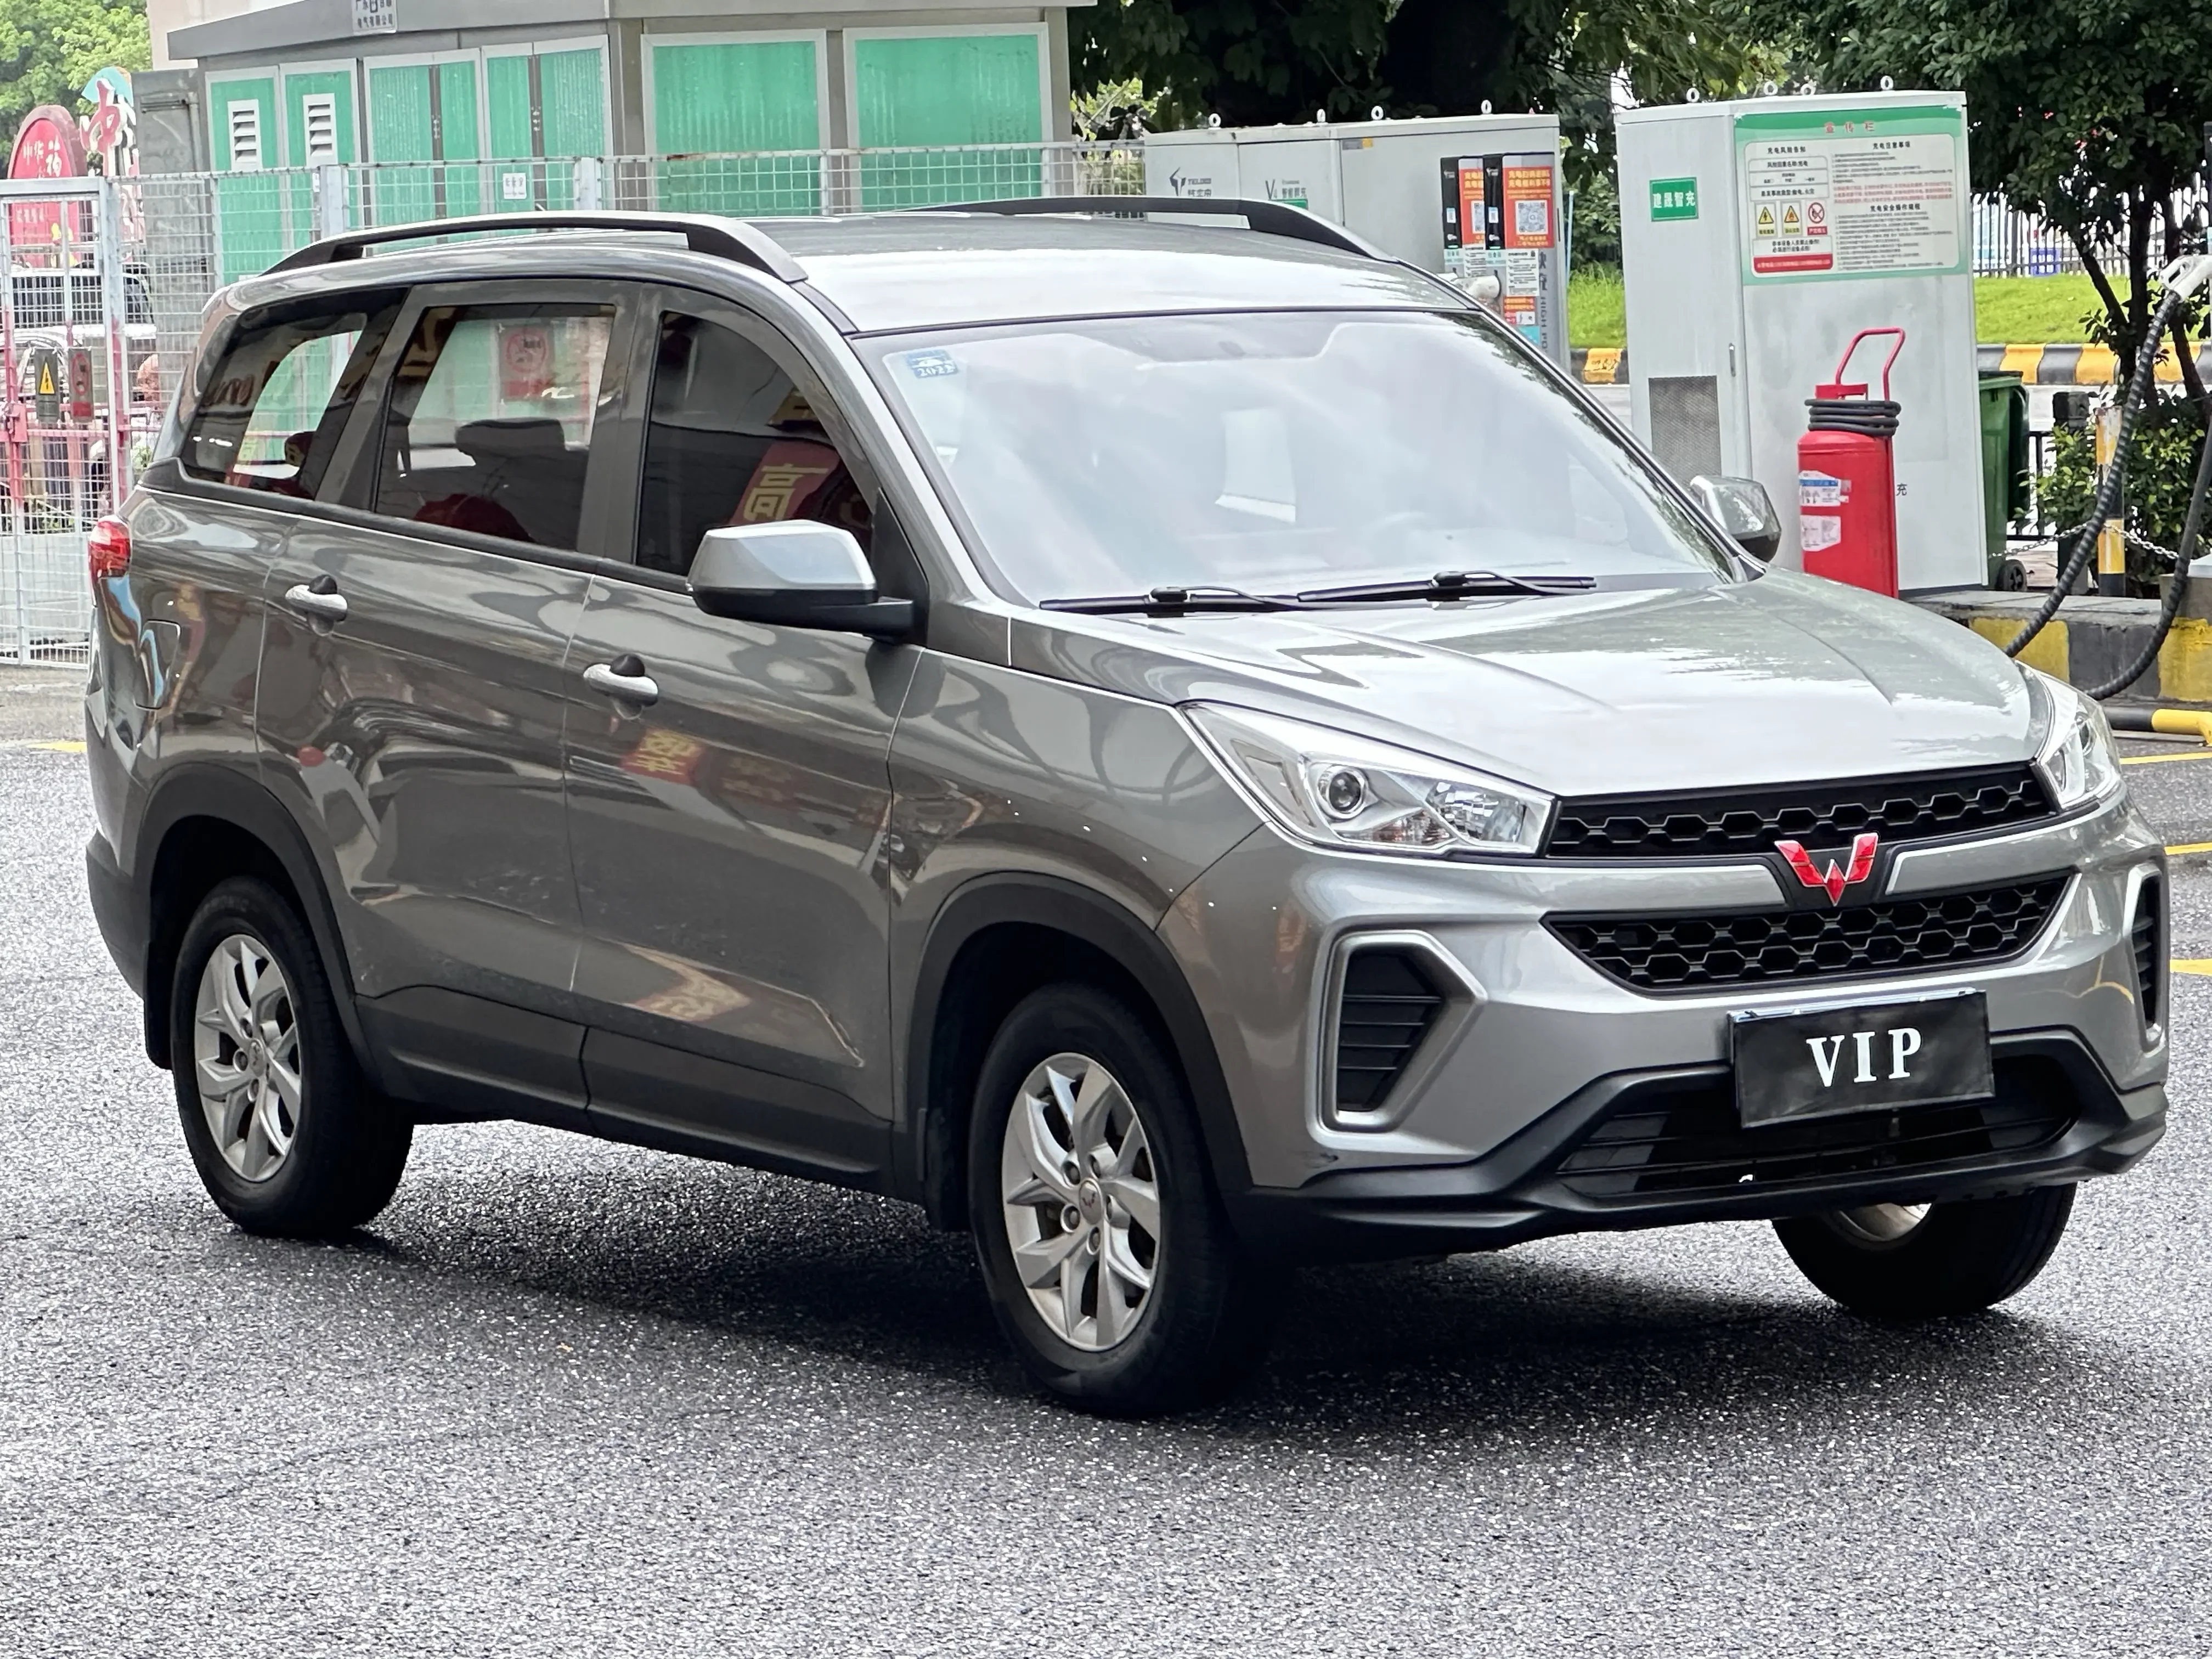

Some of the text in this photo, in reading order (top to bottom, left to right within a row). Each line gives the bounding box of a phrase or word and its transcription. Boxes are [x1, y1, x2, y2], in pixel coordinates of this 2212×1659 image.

[917, 364, 955, 377] 2022
[1896, 483, 1907, 496] 充
[1806, 1027, 1922, 1088] VIP
